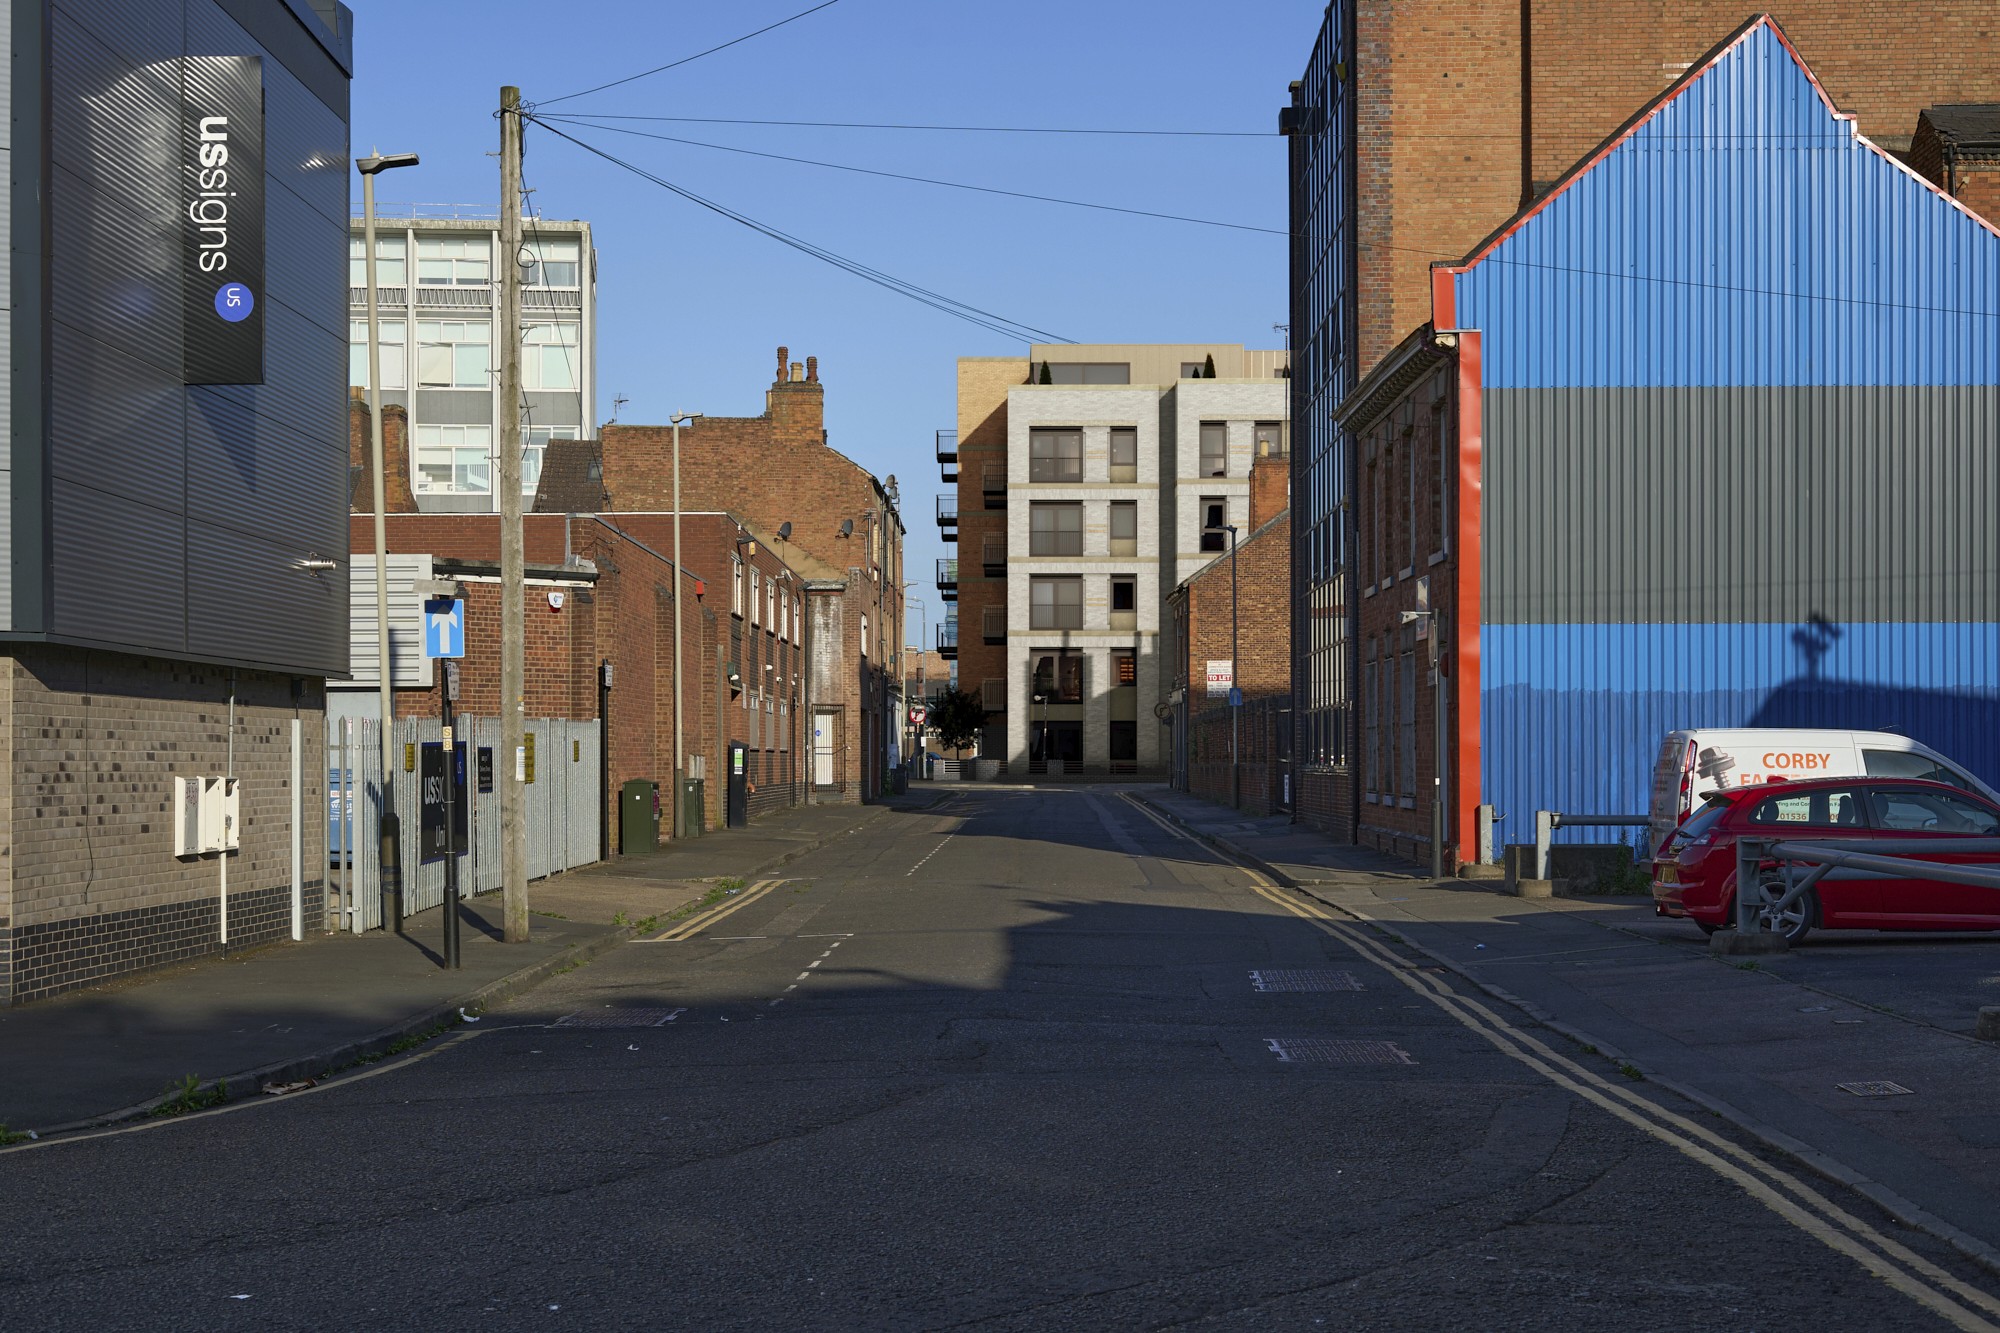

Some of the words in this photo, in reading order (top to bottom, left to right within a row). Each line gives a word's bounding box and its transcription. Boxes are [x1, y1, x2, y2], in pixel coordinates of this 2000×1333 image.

[189, 116, 238, 272] ussigns
[227, 287, 241, 308] us
[444, 728, 451, 737] S
[1762, 753, 1831, 769] CORBY
